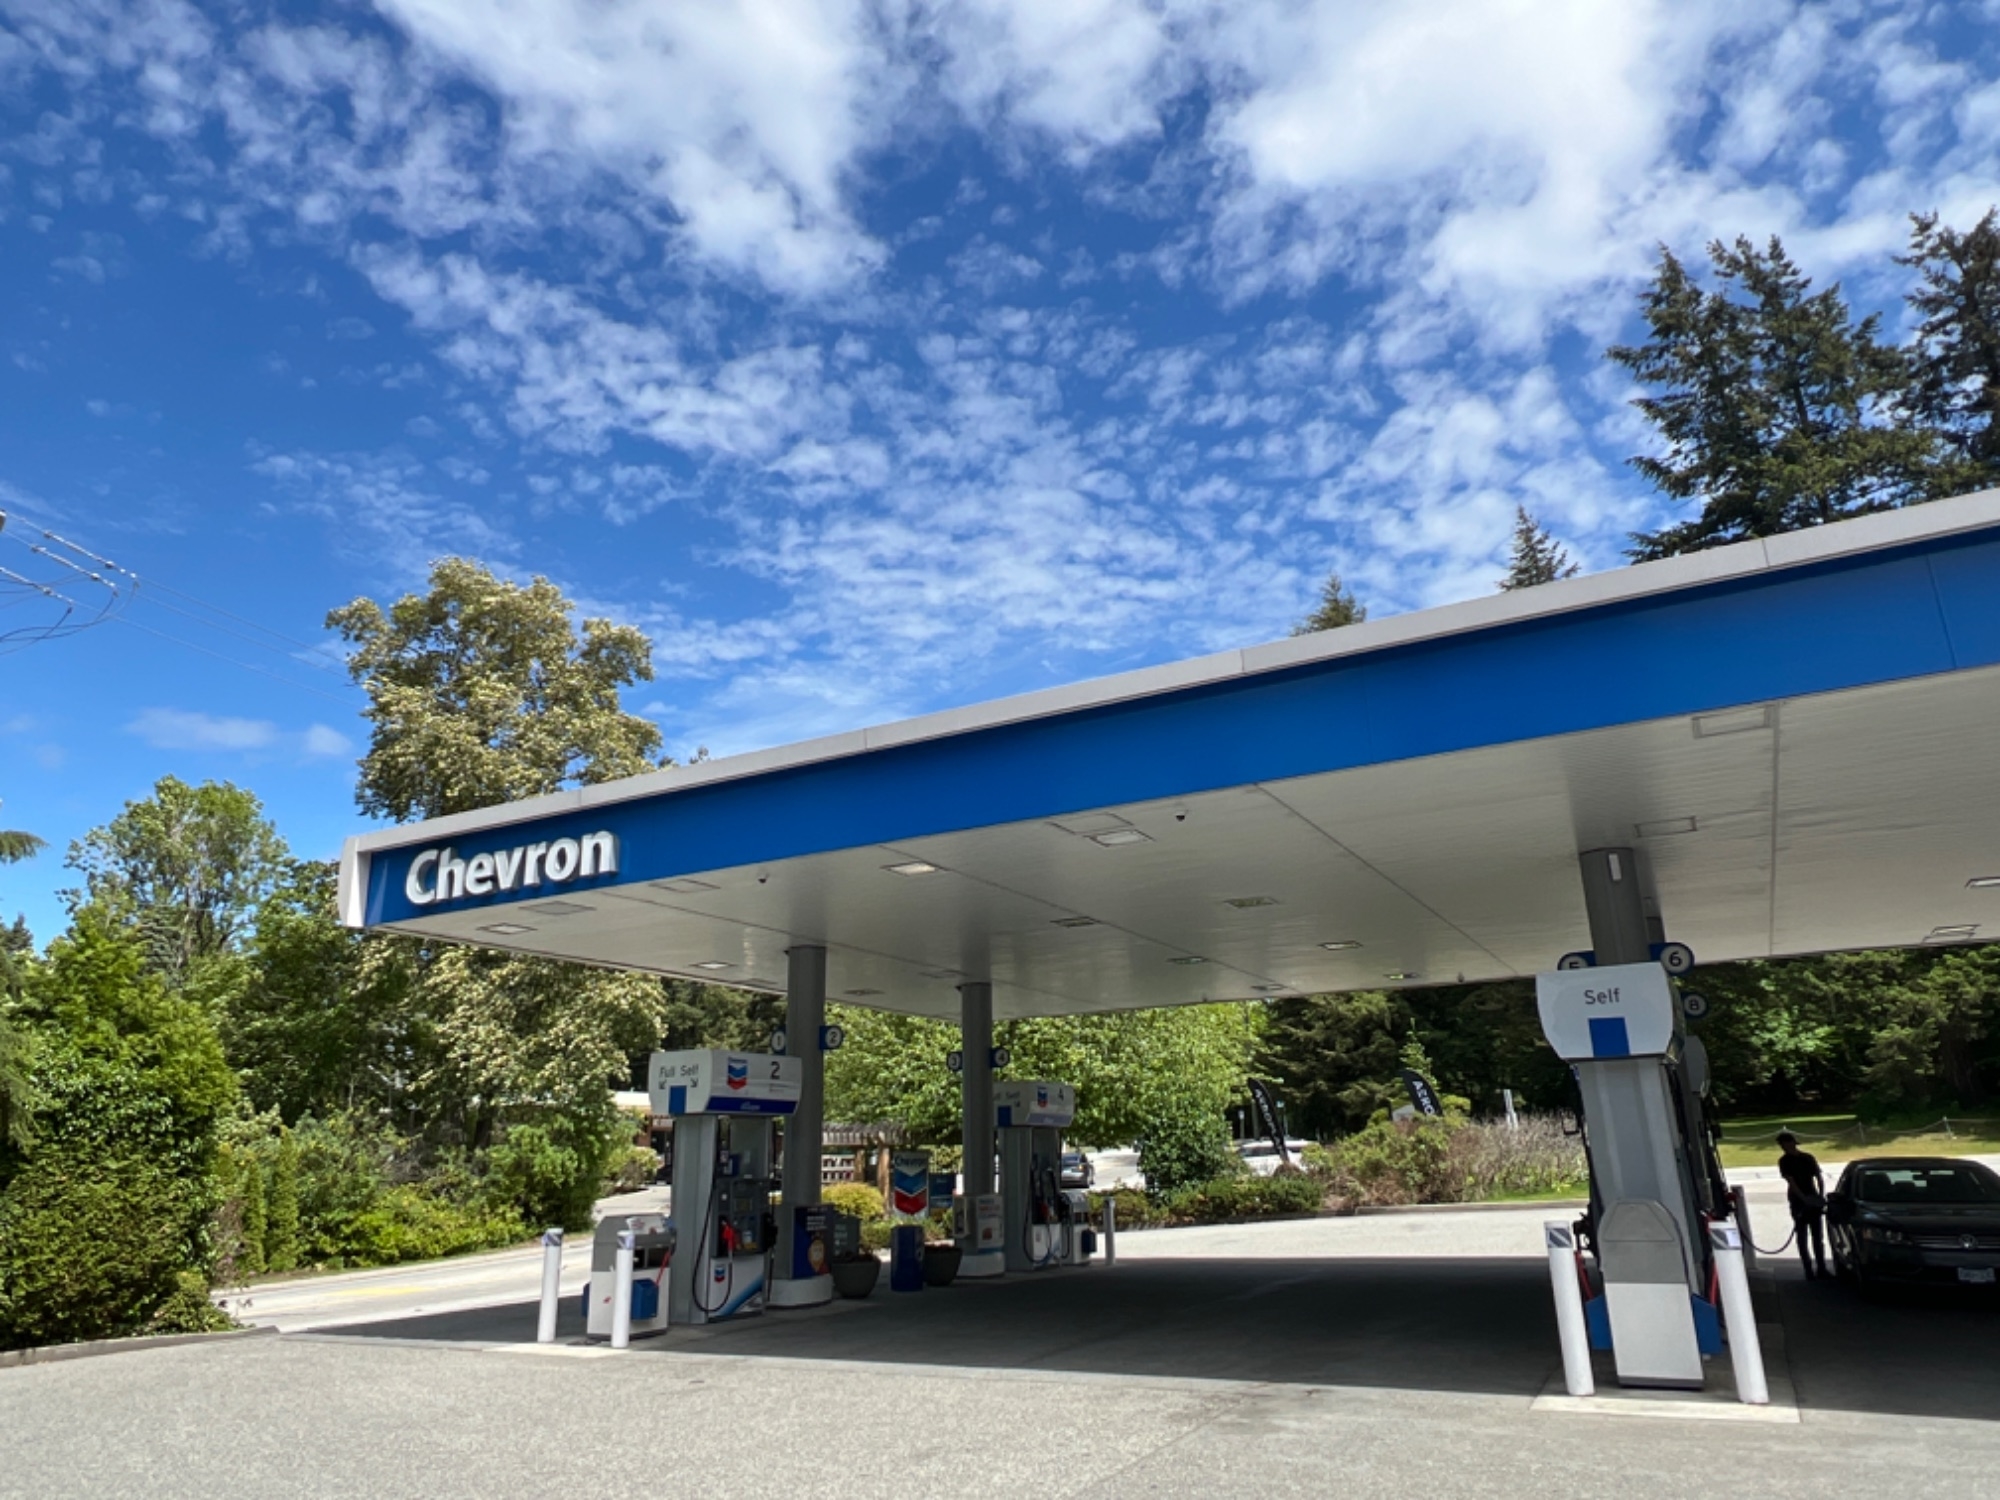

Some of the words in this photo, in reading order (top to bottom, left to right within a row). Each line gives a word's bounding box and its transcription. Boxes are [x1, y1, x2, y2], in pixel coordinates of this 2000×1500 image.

[405, 830, 619, 905] Chevron
[1668, 950, 1682, 967] 6
[1584, 987, 1620, 1005] Self
[1690, 1000, 1699, 1011] 8
[829, 1031, 838, 1045] 2
[659, 1066, 675, 1078] Full
[680, 1063, 699, 1076] Self
[770, 1061, 781, 1080] 2
